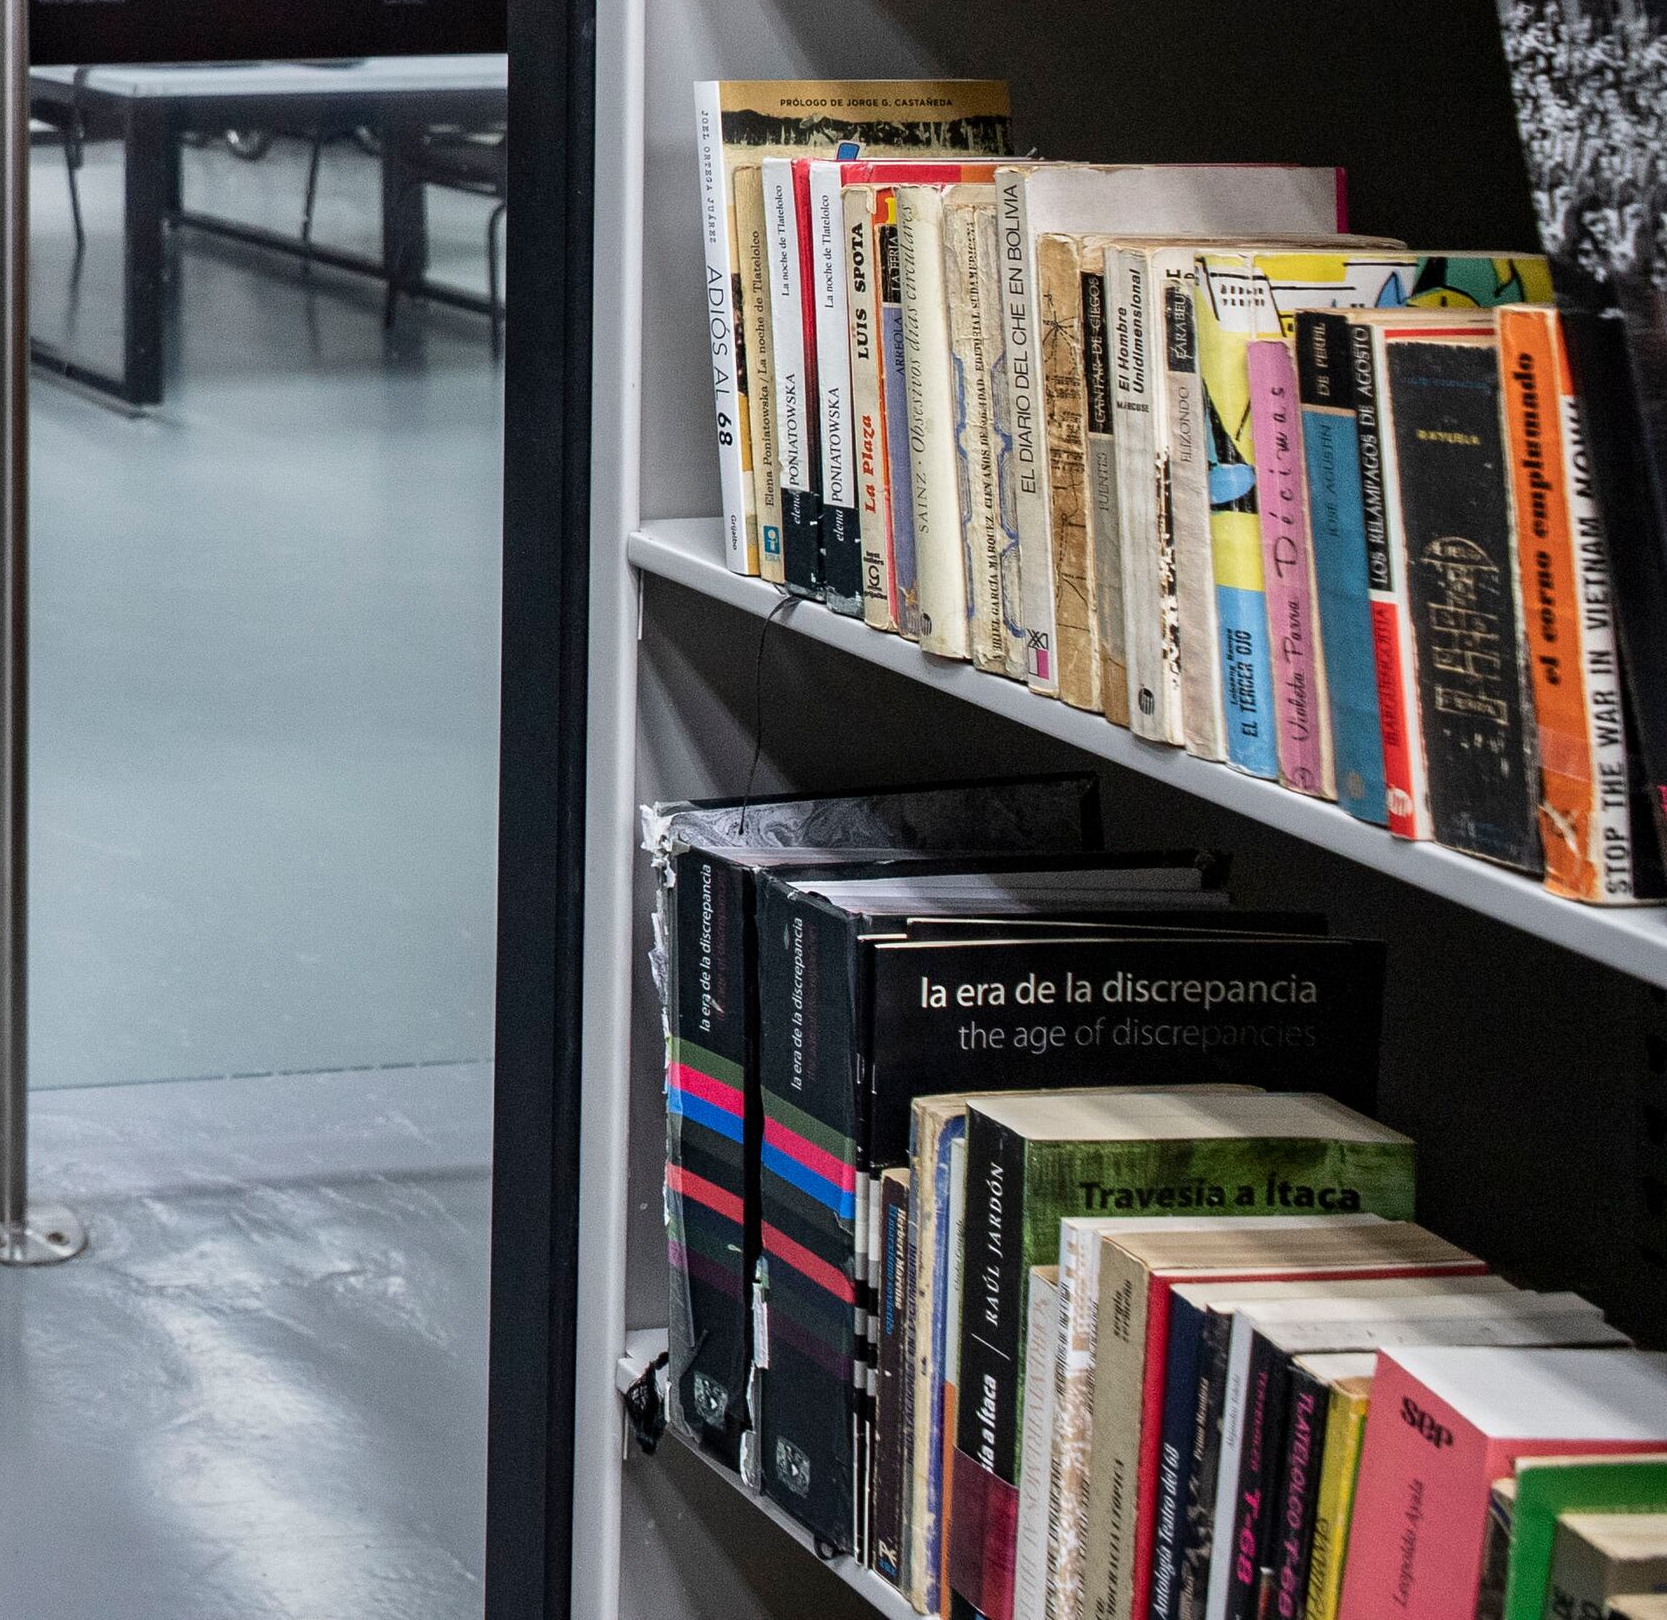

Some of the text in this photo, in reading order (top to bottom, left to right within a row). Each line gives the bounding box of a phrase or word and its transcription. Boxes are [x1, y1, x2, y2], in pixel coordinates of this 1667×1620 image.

[780, 96, 953, 107] PRÓLOGO DE JORGE G. CASTAÑEDA
[774, 185, 790, 297] La noche de Tlatelolco
[819, 196, 834, 310] La noche de Tlatelolco
[850, 222, 869, 360] LUIS SPOTA
[706, 264, 733, 445] ADIÓS AL 68
[890, 316, 906, 376] ARREOLA
[896, 204, 929, 534] SAINZ Obsesivos días circulares
[1003, 183, 1037, 493] EL DIARIO DEL CHE EN BOLIVIA
[1116, 307, 1130, 392] El Hombre
[1129, 268, 1145, 394] Unidimensional
[828, 388, 844, 543] elena PONIATOWSKA
[858, 415, 876, 513] La Plaza
[1177, 387, 1193, 464] ELIZONDO
[1353, 326, 1388, 585] LOS RELAMPAGOS DE AGOSTO
[1234, 630, 1257, 738] EL TERCER OJO
[1281, 599, 1309, 741] Violeta Parra
[698, 864, 714, 1033] la era de la discrepancia
[790, 917, 806, 1091] la era de la discrepancia
[921, 970, 1317, 1011] la era de la discrepancia
[958, 1016, 1316, 1054] the age of discrepancies
[982, 1162, 1004, 1326] RAÚL JARDÓN
[1079, 1173, 1362, 1213] Travesía a Ítaca
[975, 1373, 996, 1429] Ítaca
[982, 1430, 995, 1445] a
[1153, 1441, 1179, 1620] Antología Teatro del 68
